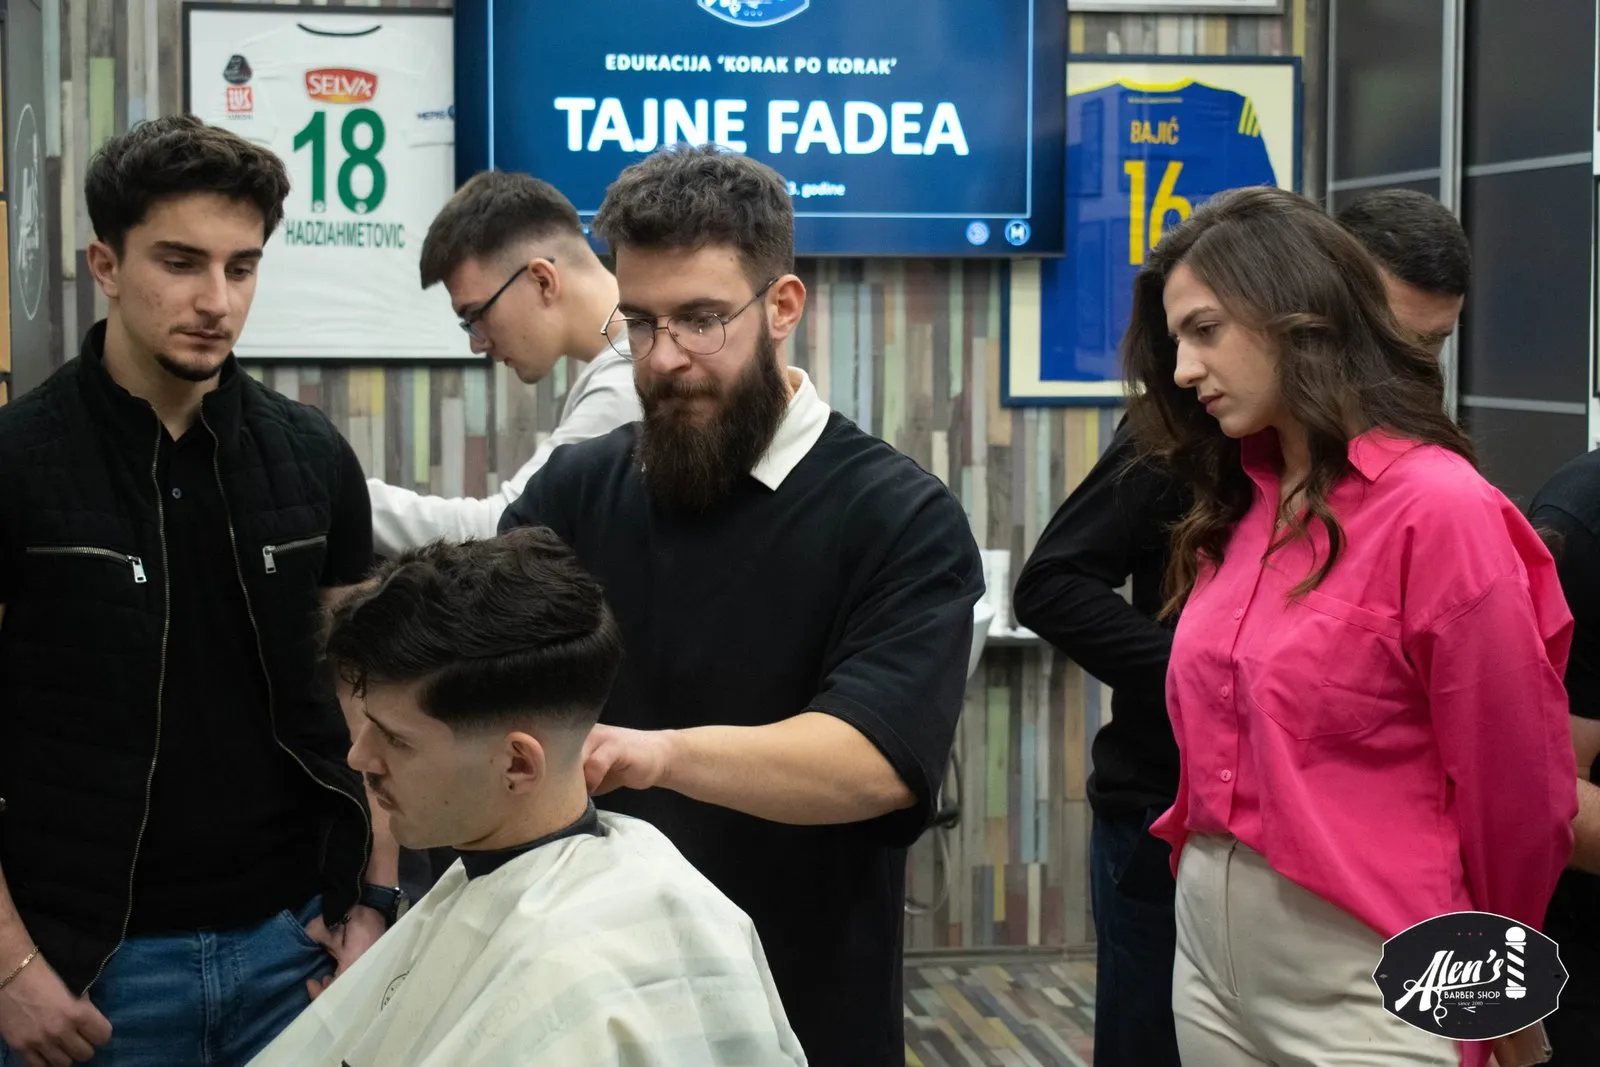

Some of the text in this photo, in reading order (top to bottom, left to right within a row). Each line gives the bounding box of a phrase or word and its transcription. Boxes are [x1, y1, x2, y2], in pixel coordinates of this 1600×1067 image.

[605, 53, 711, 72] EDUKACIJA
[795, 57, 821, 74] PO
[308, 74, 374, 98] SELVA
[554, 97, 969, 156] TAJNE FADEA
[1130, 116, 1179, 145] BAJIĆ
[293, 108, 387, 214] 18
[801, 181, 846, 198] godine
[1124, 160, 1193, 265] 16
[286, 219, 406, 249] HADZIAHMETOVIC
